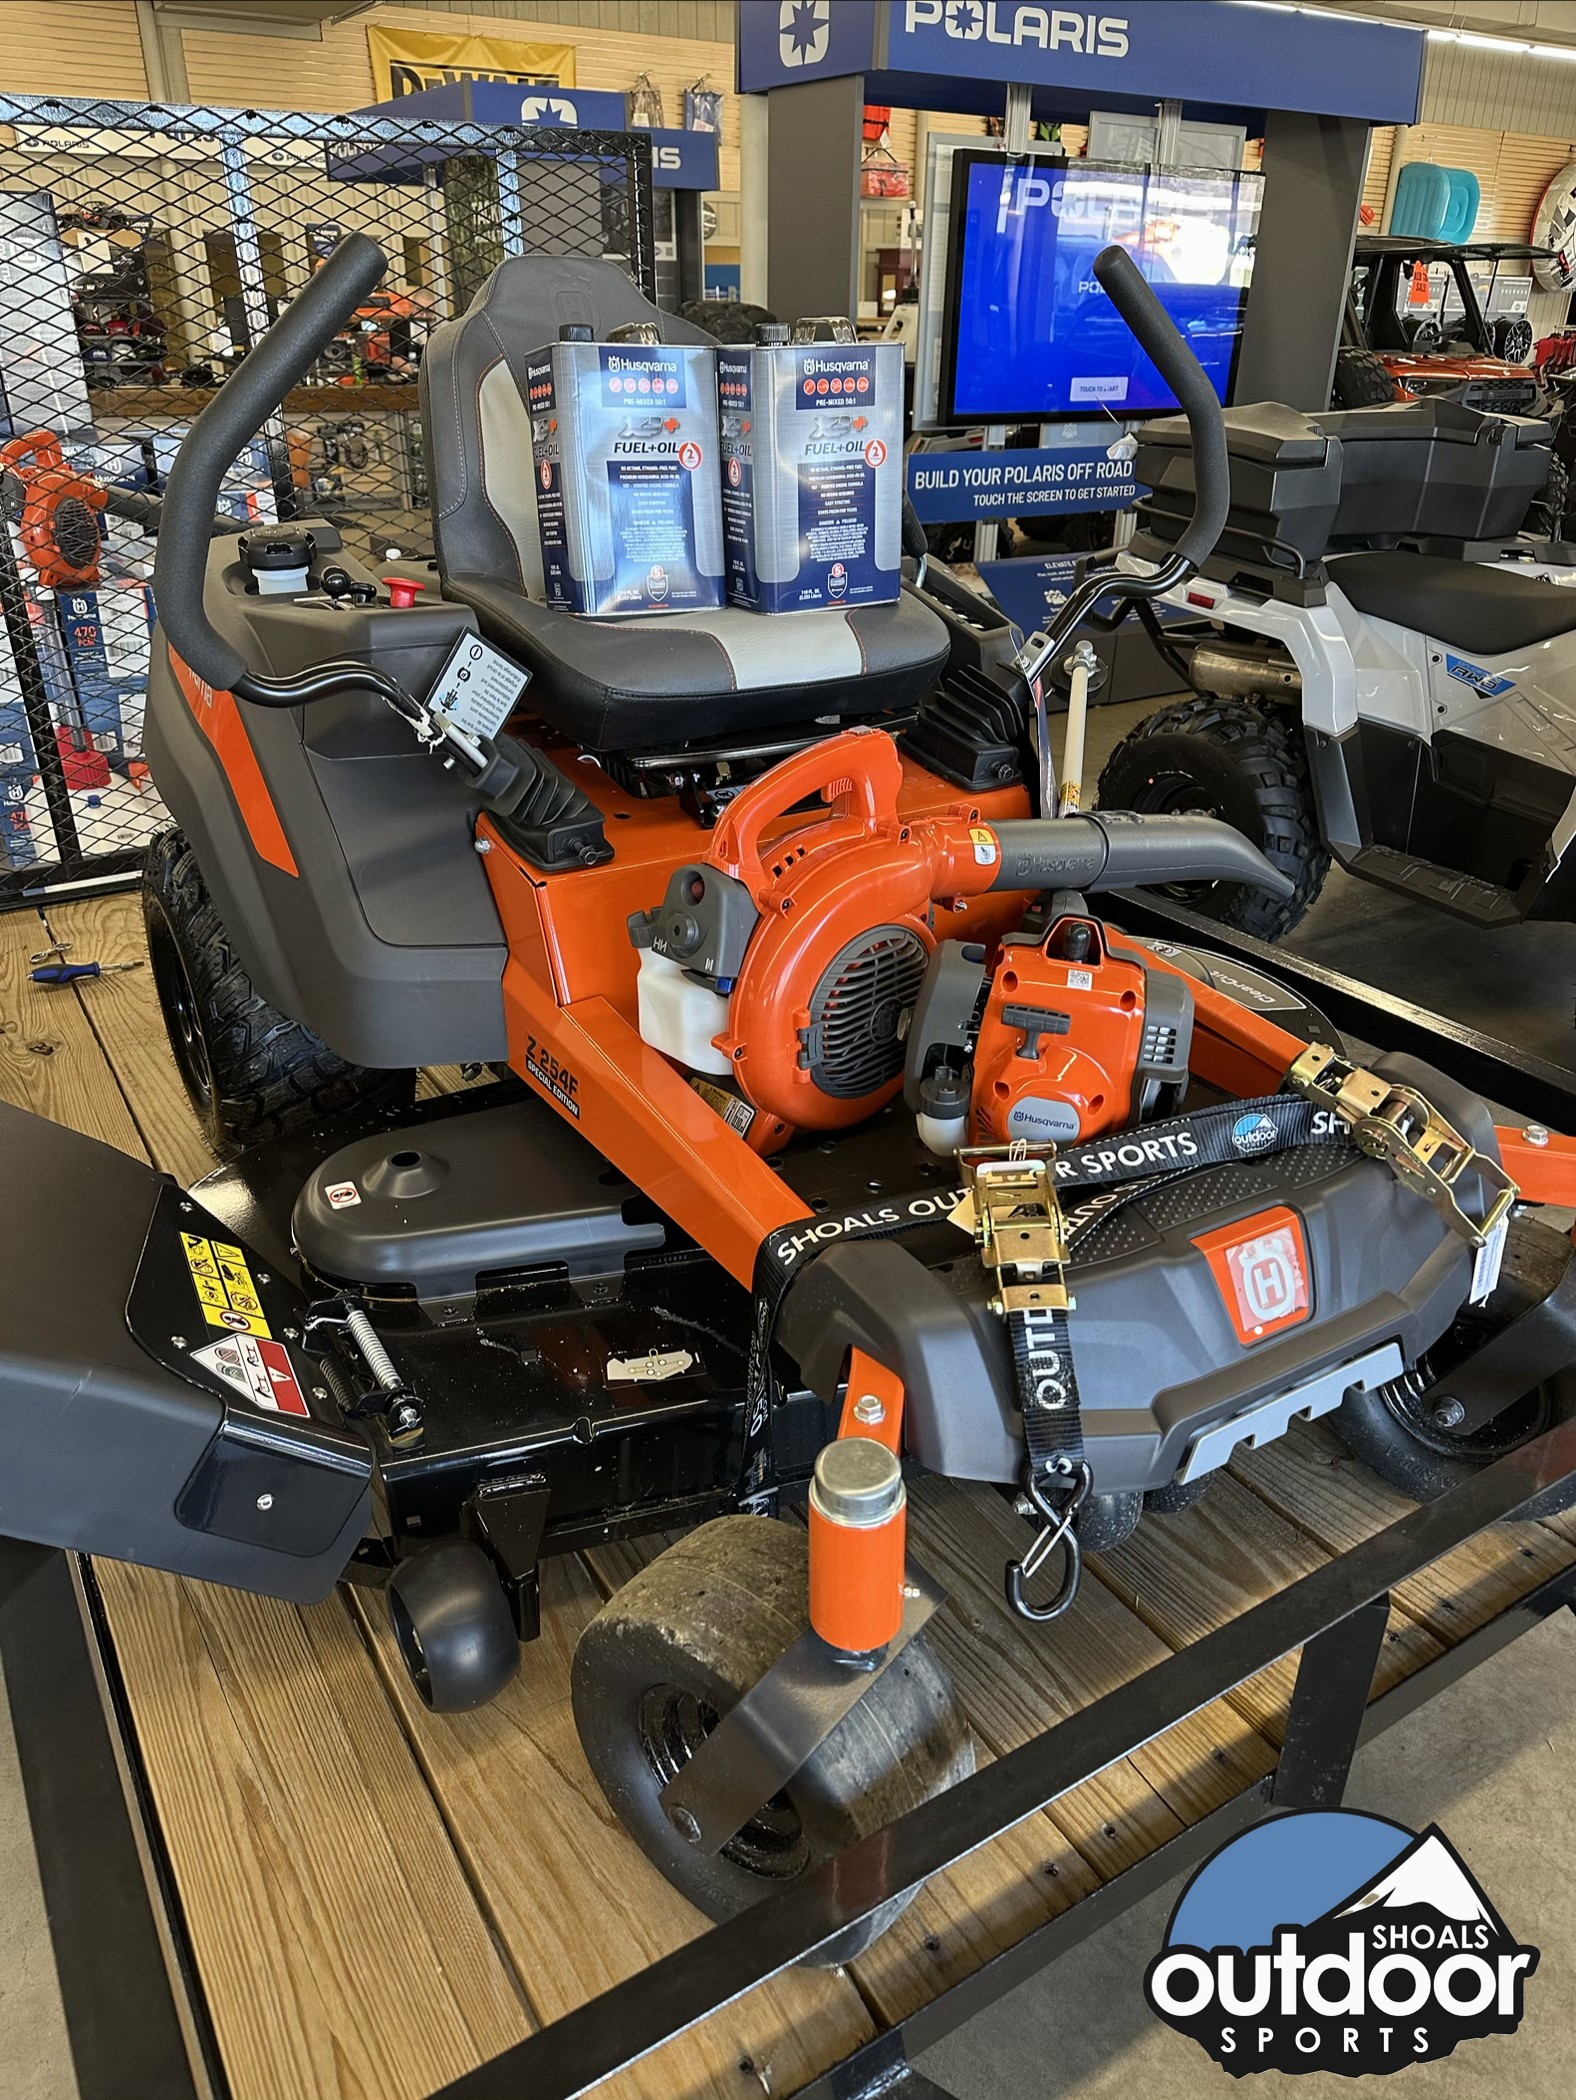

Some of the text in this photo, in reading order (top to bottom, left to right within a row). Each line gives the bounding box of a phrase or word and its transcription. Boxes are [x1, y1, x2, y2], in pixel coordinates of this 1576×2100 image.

[905, 0, 1129, 58] POLARIS
[620, 358, 677, 373] Husqvarna
[723, 363, 748, 373] Husqvarna
[815, 358, 869, 373] Husqvarna
[624, 398, 667, 406] PRE-MIXED 50:1
[816, 399, 844, 407] PRE-MIXED
[614, 442, 680, 454] FUEL+OIL
[804, 441, 866, 456] FUEL+OIL
[914, 460, 1133, 490] BUILD YOUR POLARIS OFF ROAD
[973, 484, 1136, 507] TOUCH THE SCREEN TO GET STARTED
[1045, 560, 1073, 569] ELEVATE
[1030, 856, 1095, 876] Husqvarna
[1209, 970, 1276, 1004] ClearCut
[527, 1034, 579, 1096] Z 254F
[527, 1060, 579, 1116] SPECIAL EDITION
[1024, 1113, 1075, 1130] Husqvarna
[1234, 1130, 1276, 1145] outdoor
[1080, 1131, 1198, 1175] SPORTS
[777, 1207, 901, 1266] SHOALS
